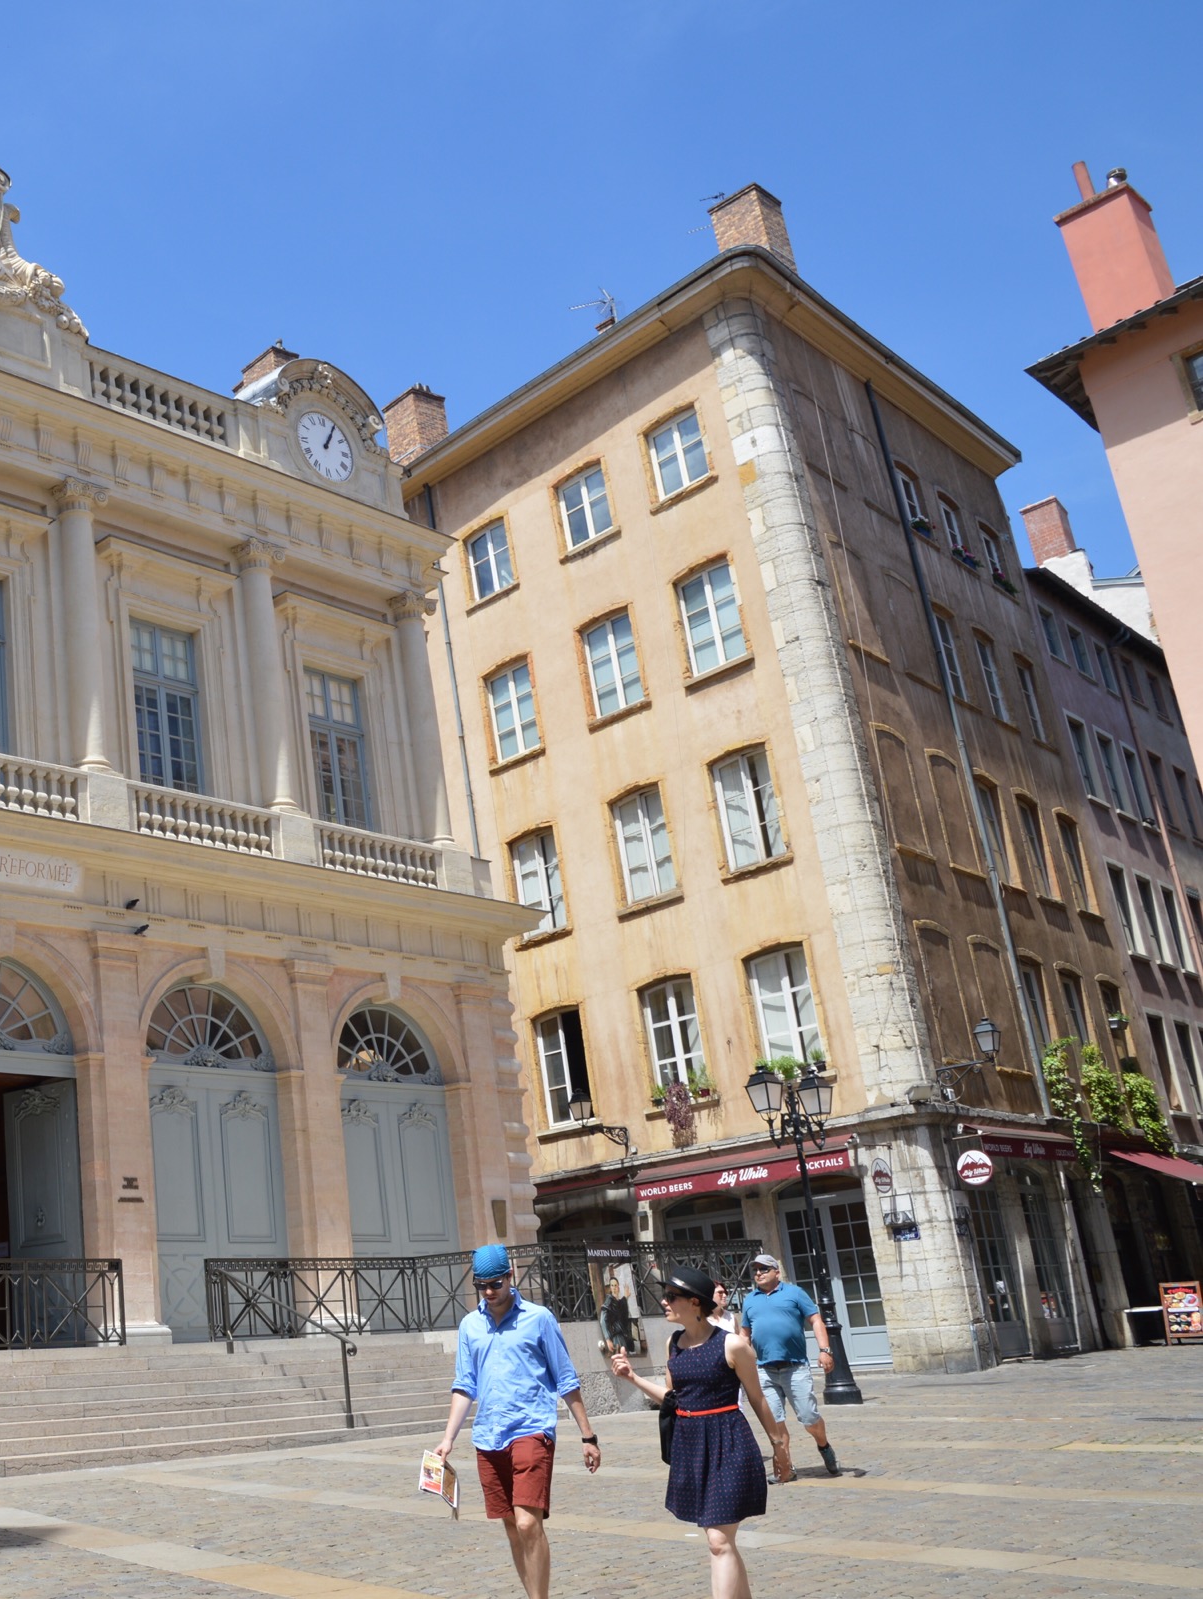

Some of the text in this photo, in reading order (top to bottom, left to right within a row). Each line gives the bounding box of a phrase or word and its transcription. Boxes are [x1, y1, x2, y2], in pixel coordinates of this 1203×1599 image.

[717, 1166, 769, 1187] Big White
[962, 1167, 990, 1178] Big White
[639, 1181, 693, 1197] WORLD BEERS
